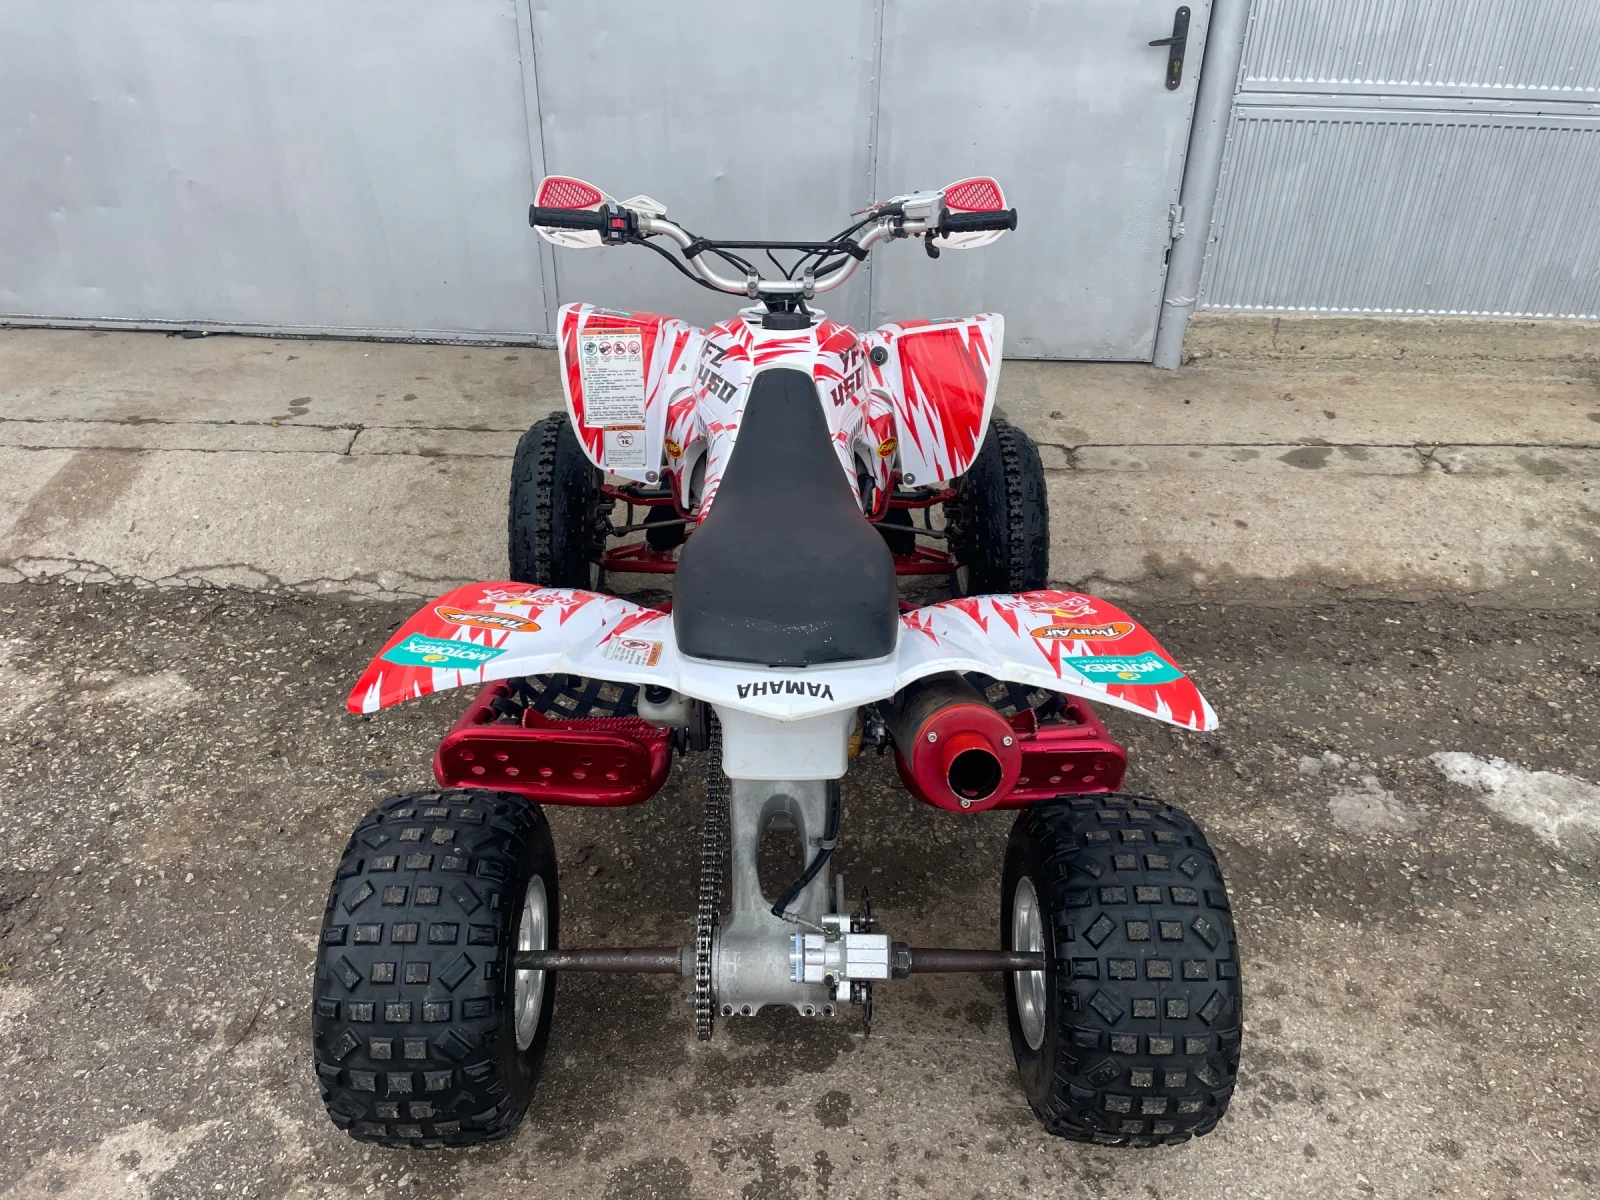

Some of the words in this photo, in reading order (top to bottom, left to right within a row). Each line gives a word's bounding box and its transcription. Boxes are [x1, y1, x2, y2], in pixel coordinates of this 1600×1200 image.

[476, 614, 529, 629] Twin
[1043, 628, 1071, 637] Air
[1071, 626, 1120, 637] Twin
[411, 637, 468, 650] Switzerland
[404, 641, 489, 660] MOTOREX
[1076, 660, 1164, 673] MOTOREX
[736, 680, 834, 701] YAMAHA
